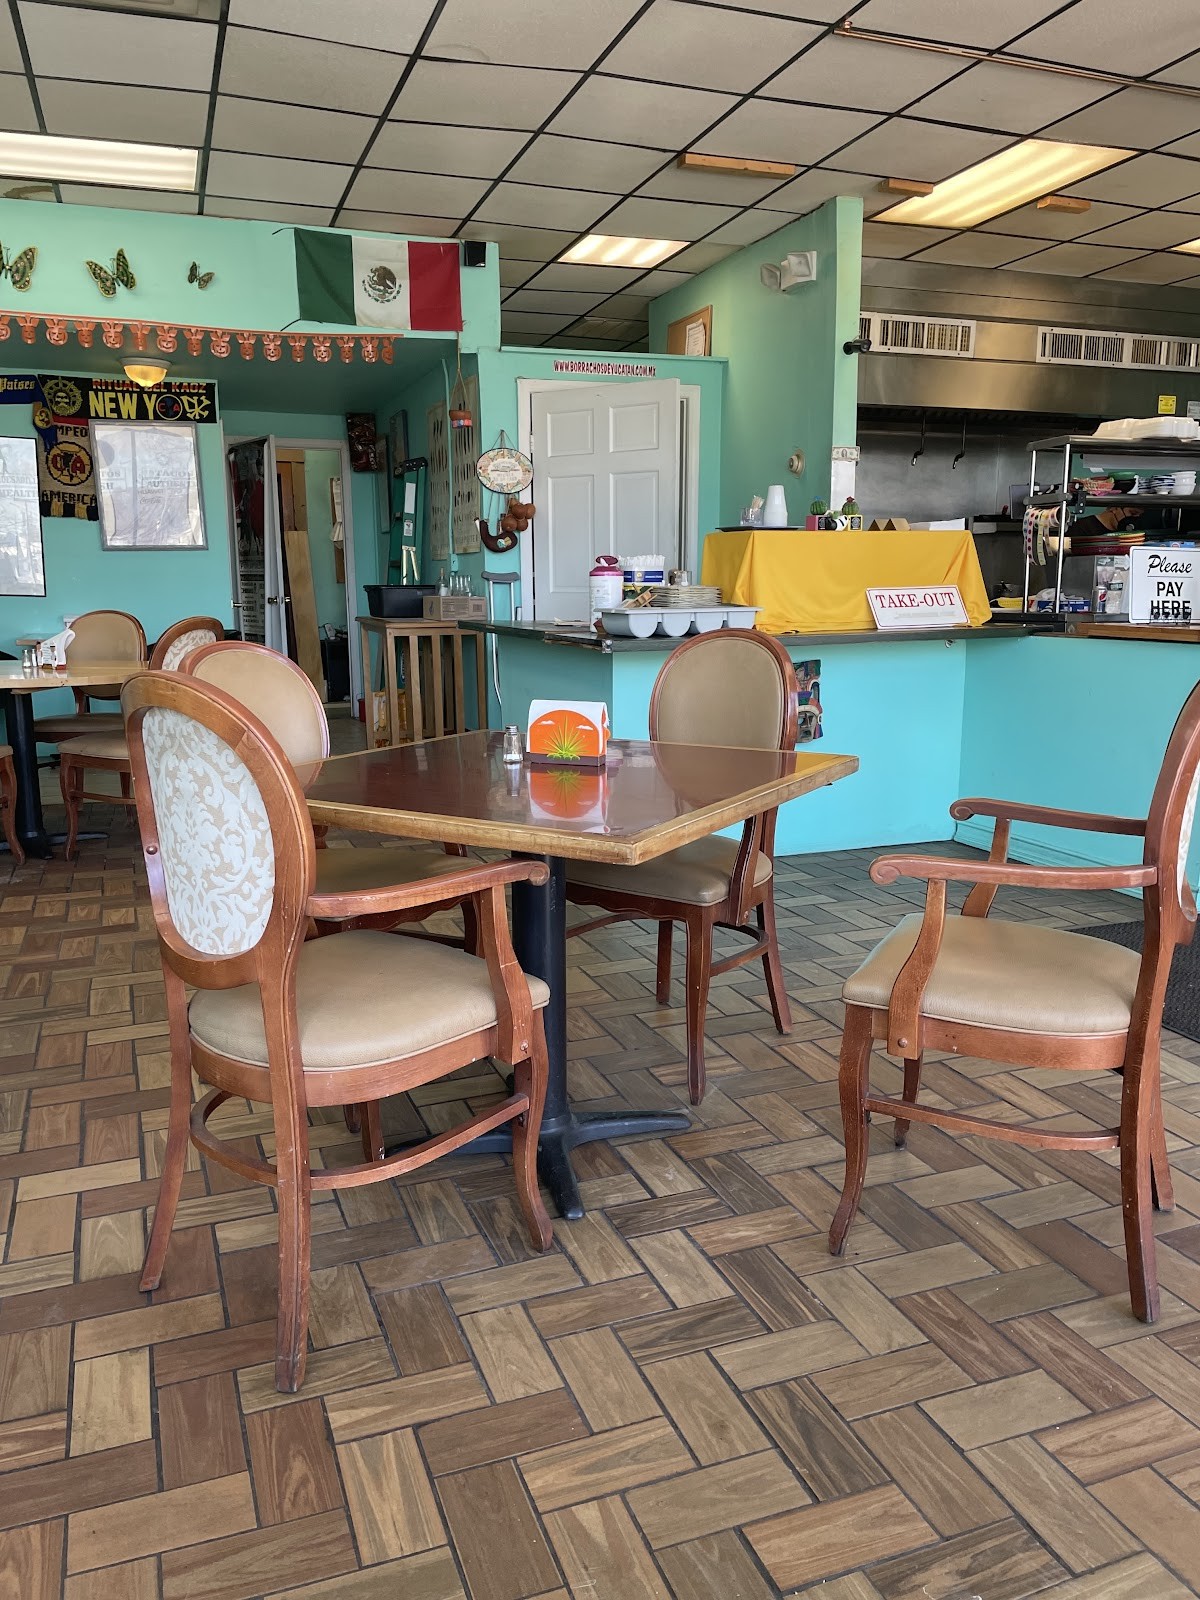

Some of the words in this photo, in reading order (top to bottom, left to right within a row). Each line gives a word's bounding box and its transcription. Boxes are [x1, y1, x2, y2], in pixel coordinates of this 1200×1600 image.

[92, 379, 140, 391] RITUAL
[171, 382, 206, 393] KAOZ
[89, 391, 137, 419] NEW
[54, 425, 89, 437] MPEO
[42, 490, 97, 506] AMERICA
[1147, 554, 1192, 573] Please
[1157, 582, 1183, 596] PAY
[875, 592, 955, 608] TAKE-OUT
[1150, 600, 1191, 616] HERE
